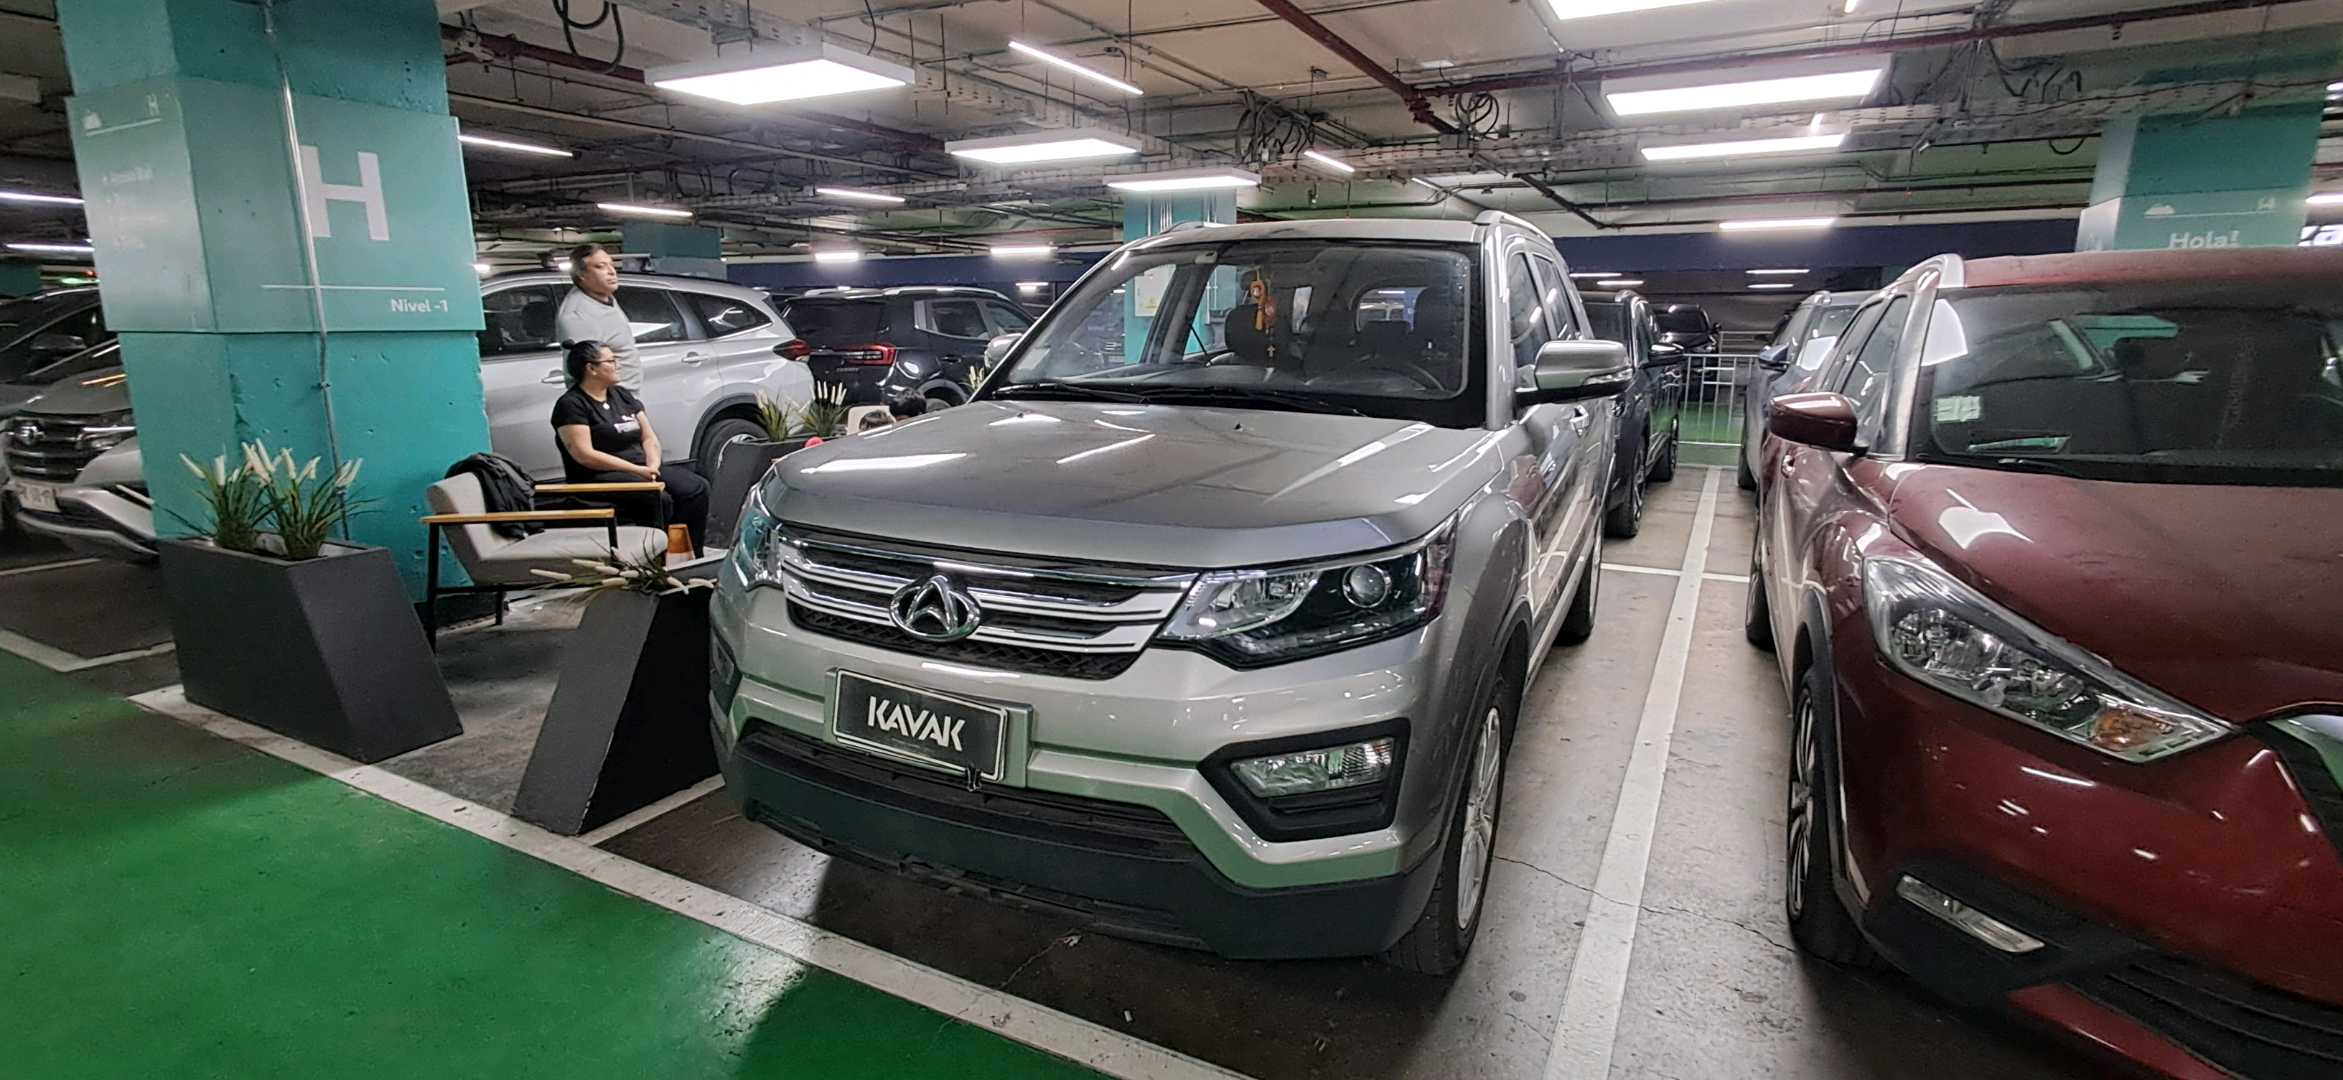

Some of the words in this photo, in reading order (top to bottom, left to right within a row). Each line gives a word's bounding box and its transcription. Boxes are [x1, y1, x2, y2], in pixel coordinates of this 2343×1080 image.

[298, 145, 390, 241] H
[2169, 230, 2240, 249] Hola!
[391, 298, 431, 313] Nivel
[433, 299, 448, 313] -1
[867, 696, 966, 751] KAVAK
